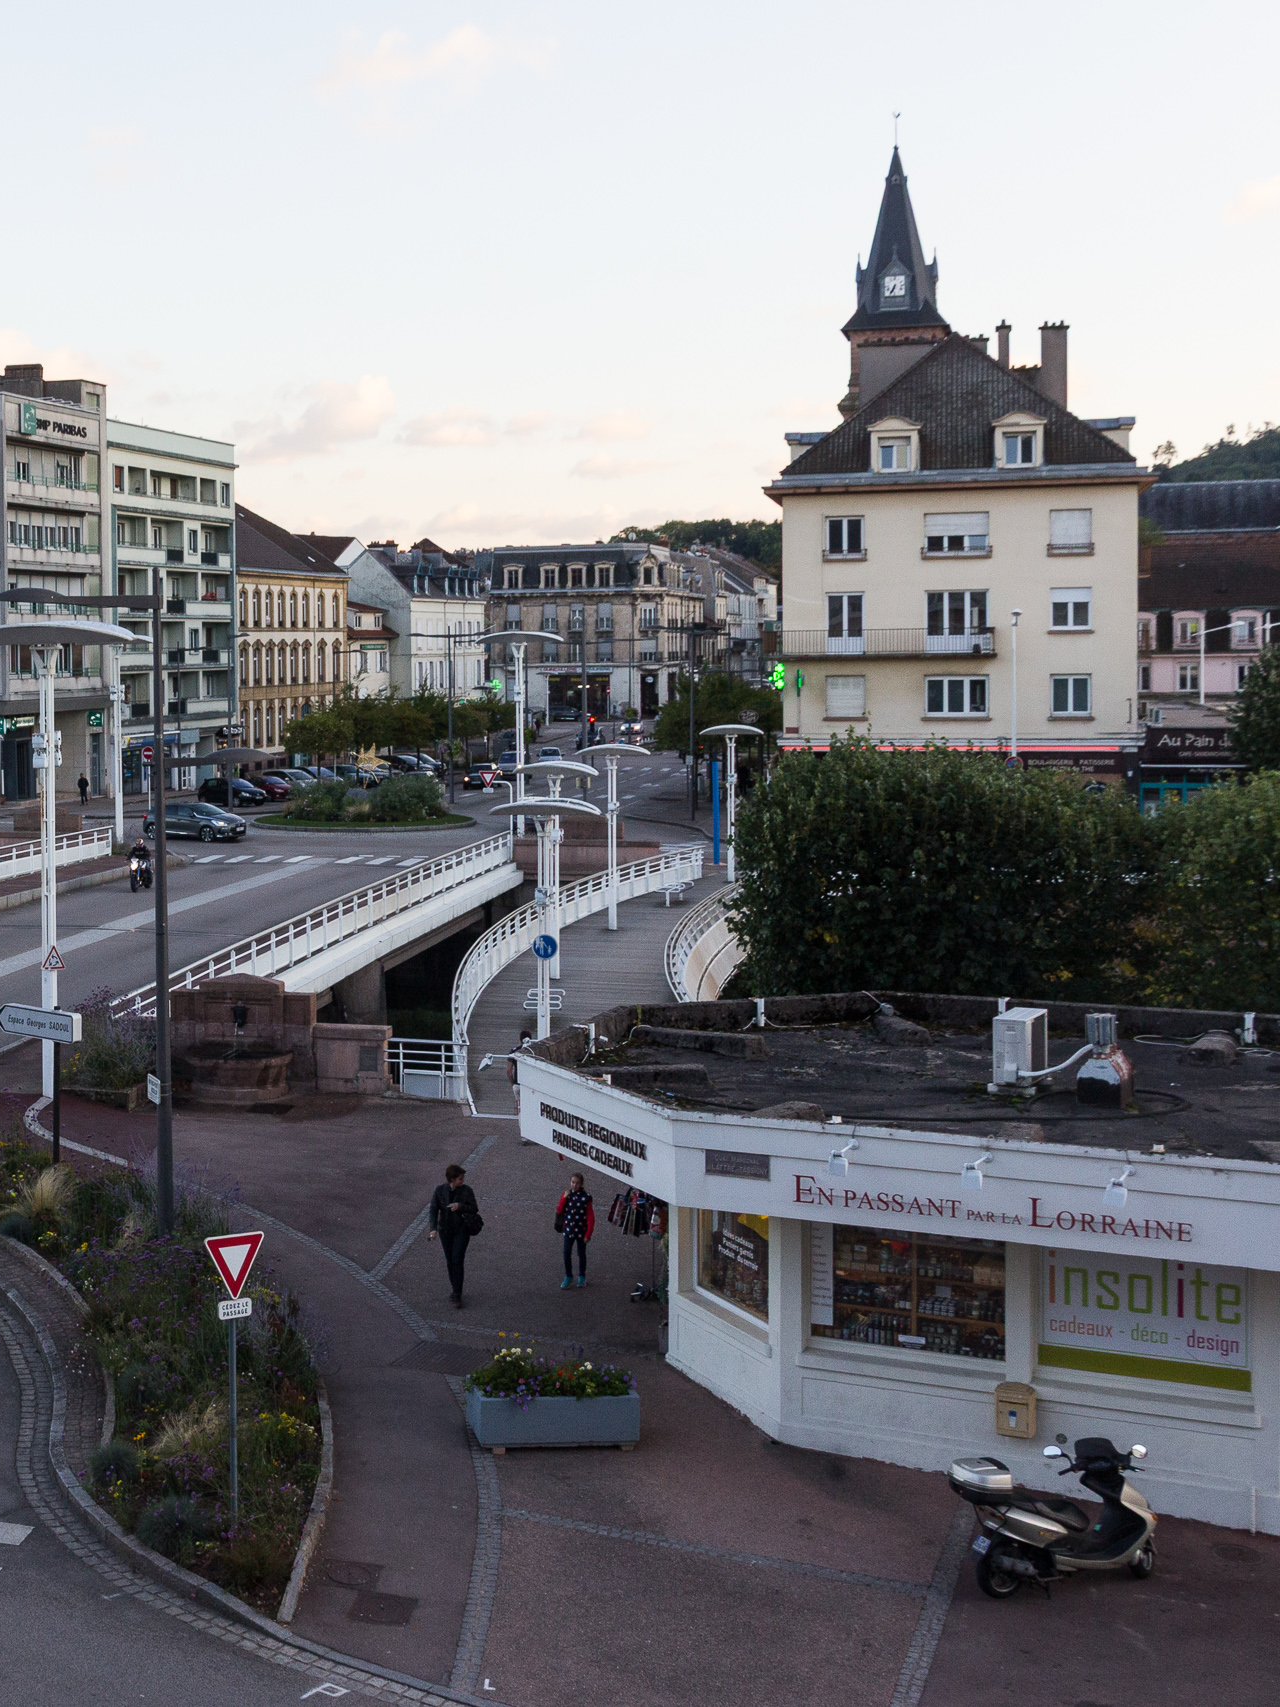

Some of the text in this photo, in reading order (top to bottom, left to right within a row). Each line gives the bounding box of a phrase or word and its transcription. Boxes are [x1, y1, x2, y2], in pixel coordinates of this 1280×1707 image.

[52, 421, 87, 438] PARIBAS
[1157, 734, 1181, 747] Au
[1185, 733, 1214, 747] Pain
[7, 1014, 70, 1033] Espace Georges SADOUL
[540, 1101, 648, 1161] PRODUITS REGIONAUX
[552, 1128, 634, 1178] PANIERS CADEAUX
[842, 1189, 962, 1219] PASSANT
[966, 1209, 996, 1223] PAR
[1001, 1212, 1023, 1226] LA
[1028, 1196, 1193, 1243] LORRAINE
[1049, 1250, 1241, 1325] insolite
[221, 1302, 240, 1311] CÉDEZ
[222, 1308, 248, 1317] PASSAGE
[1049, 1315, 1113, 1338] cadeaux
[1131, 1323, 1169, 1345] déco
[1186, 1329, 1240, 1357] design
